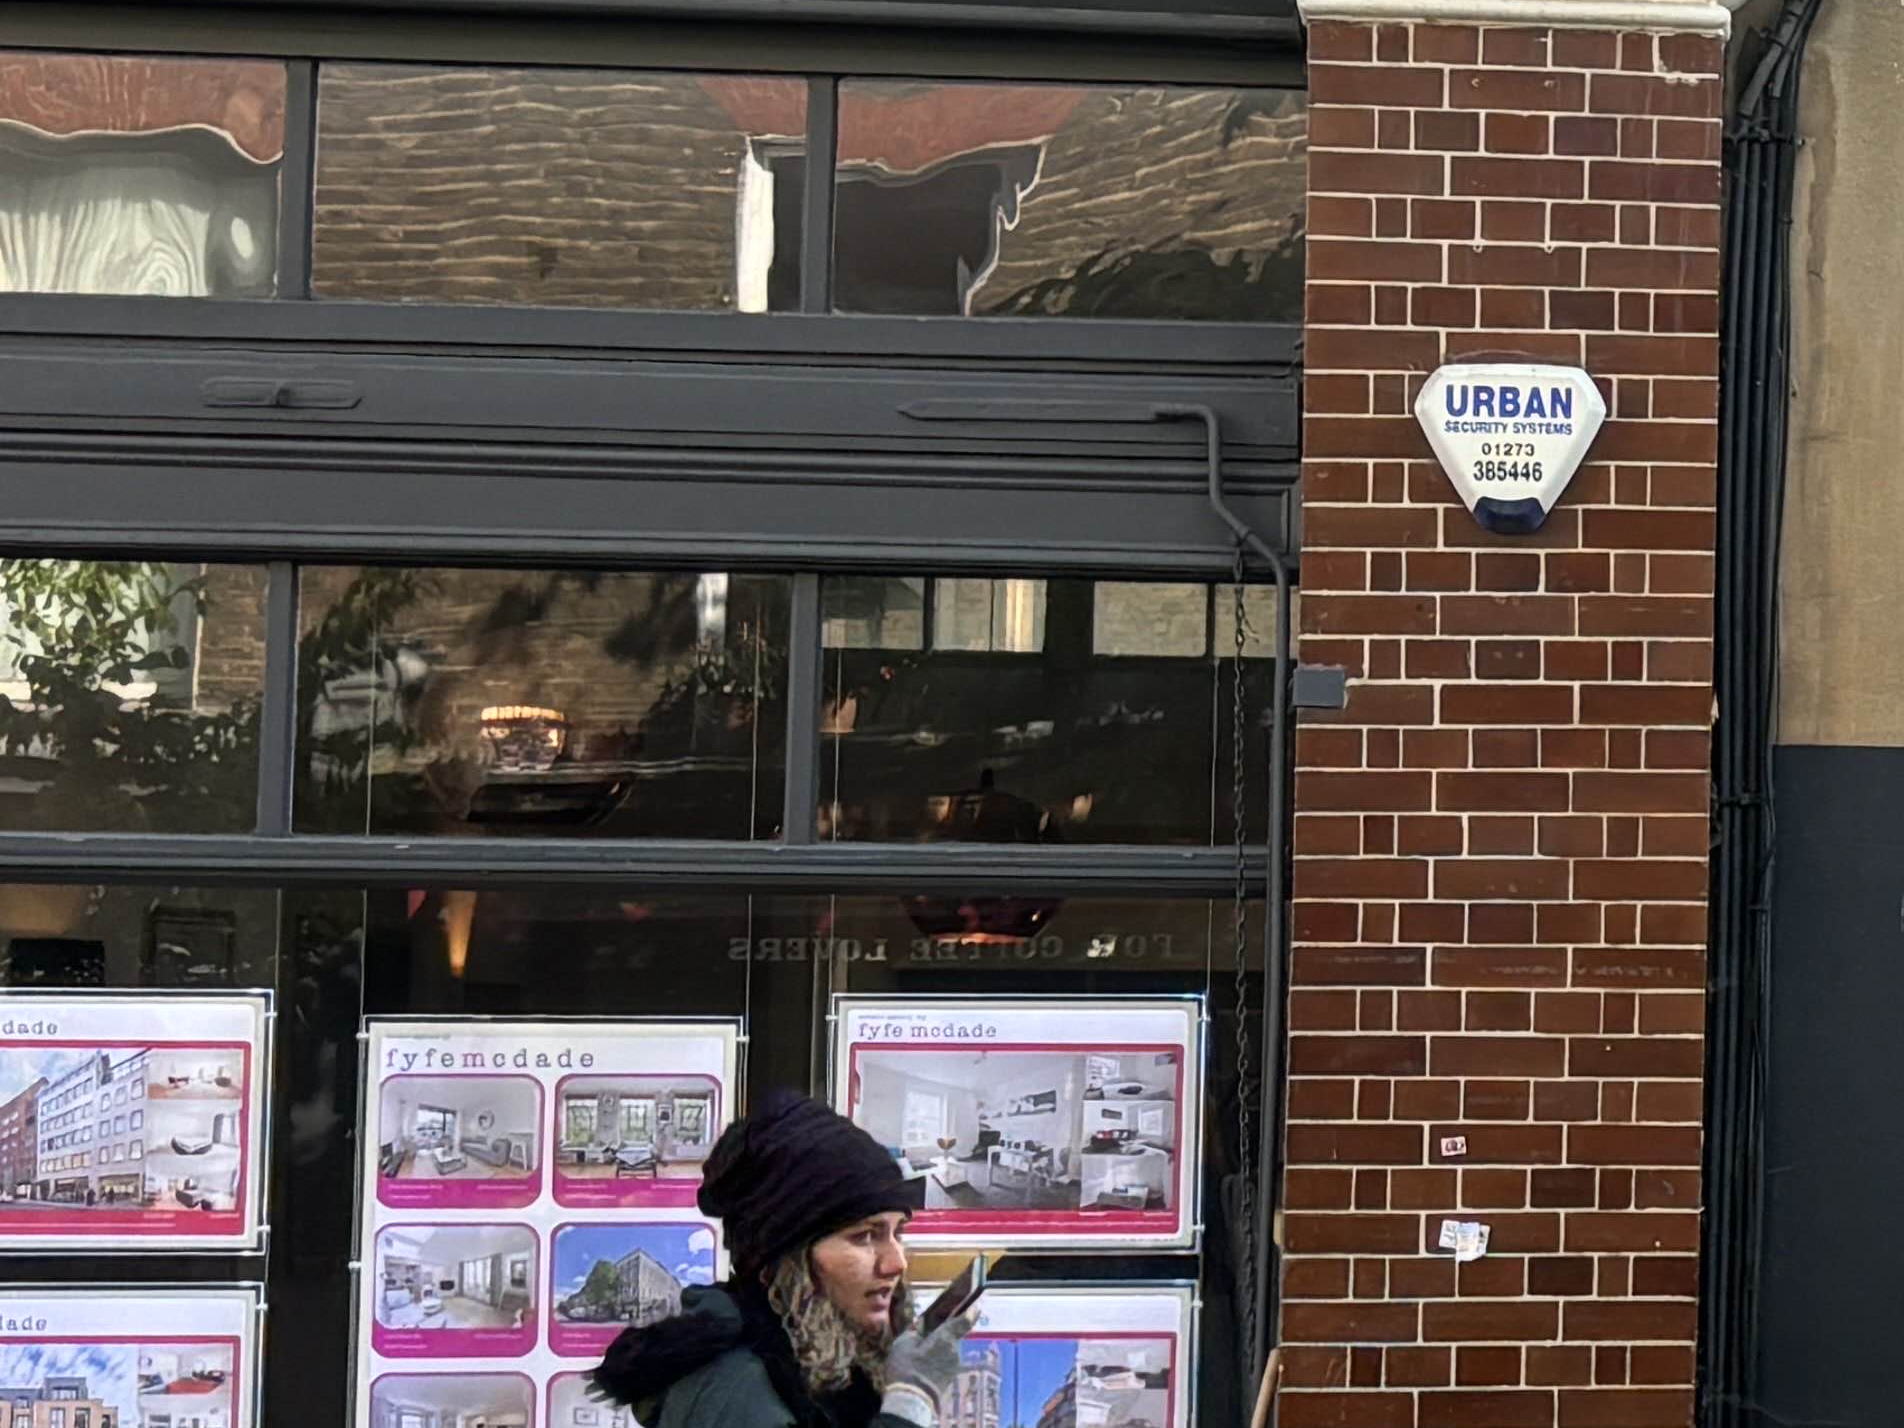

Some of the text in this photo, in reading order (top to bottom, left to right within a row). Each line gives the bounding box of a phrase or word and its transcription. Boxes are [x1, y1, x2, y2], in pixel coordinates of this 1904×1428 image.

[1445, 384, 1572, 419] URBAN
[1444, 421, 1573, 436] SECURITY SYSTEMS
[1481, 442, 1535, 457] 01273
[1473, 460, 1543, 482] 385446
